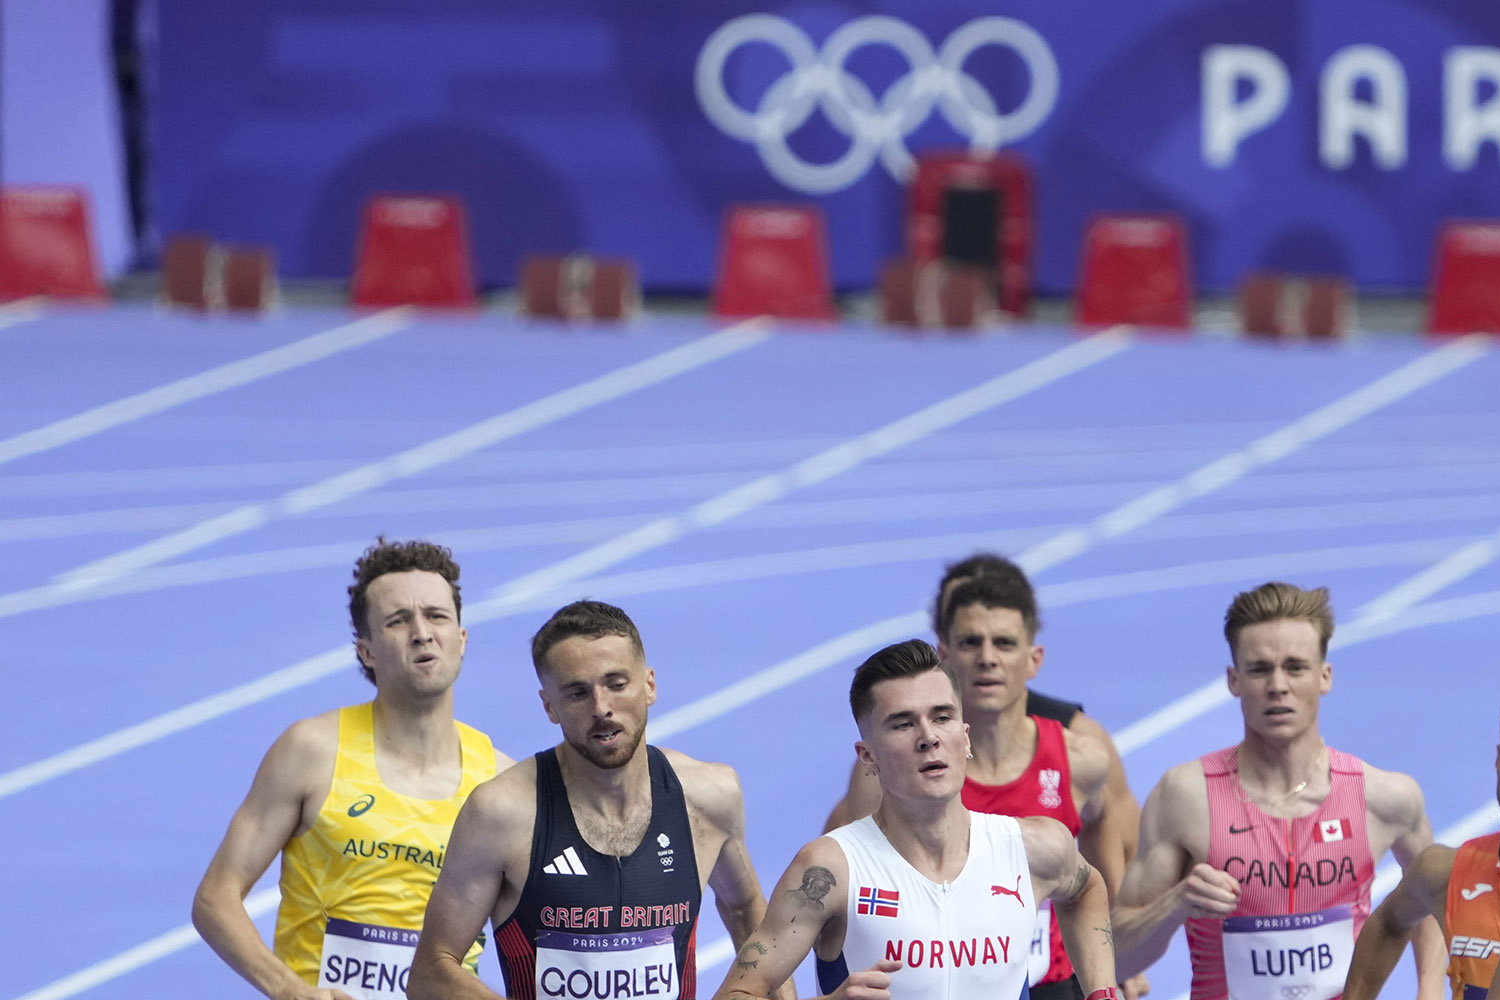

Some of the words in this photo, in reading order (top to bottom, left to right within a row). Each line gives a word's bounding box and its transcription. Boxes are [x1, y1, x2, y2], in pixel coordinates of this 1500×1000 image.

[343, 838, 444, 869] AUSTRAL
[1224, 856, 1357, 889] CANADA
[540, 906, 613, 928] GREAT
[620, 901, 690, 927] BRITAIN
[1255, 919, 1291, 928] PARIS
[362, 927, 398, 942] PARIS
[572, 938, 609, 947] PARIS
[613, 936, 644, 947] 2024
[885, 935, 1011, 969] NORWAY
[1251, 944, 1333, 977] LUMB
[324, 955, 411, 993] SPEN
[540, 963, 673, 1000] GOURLEY
